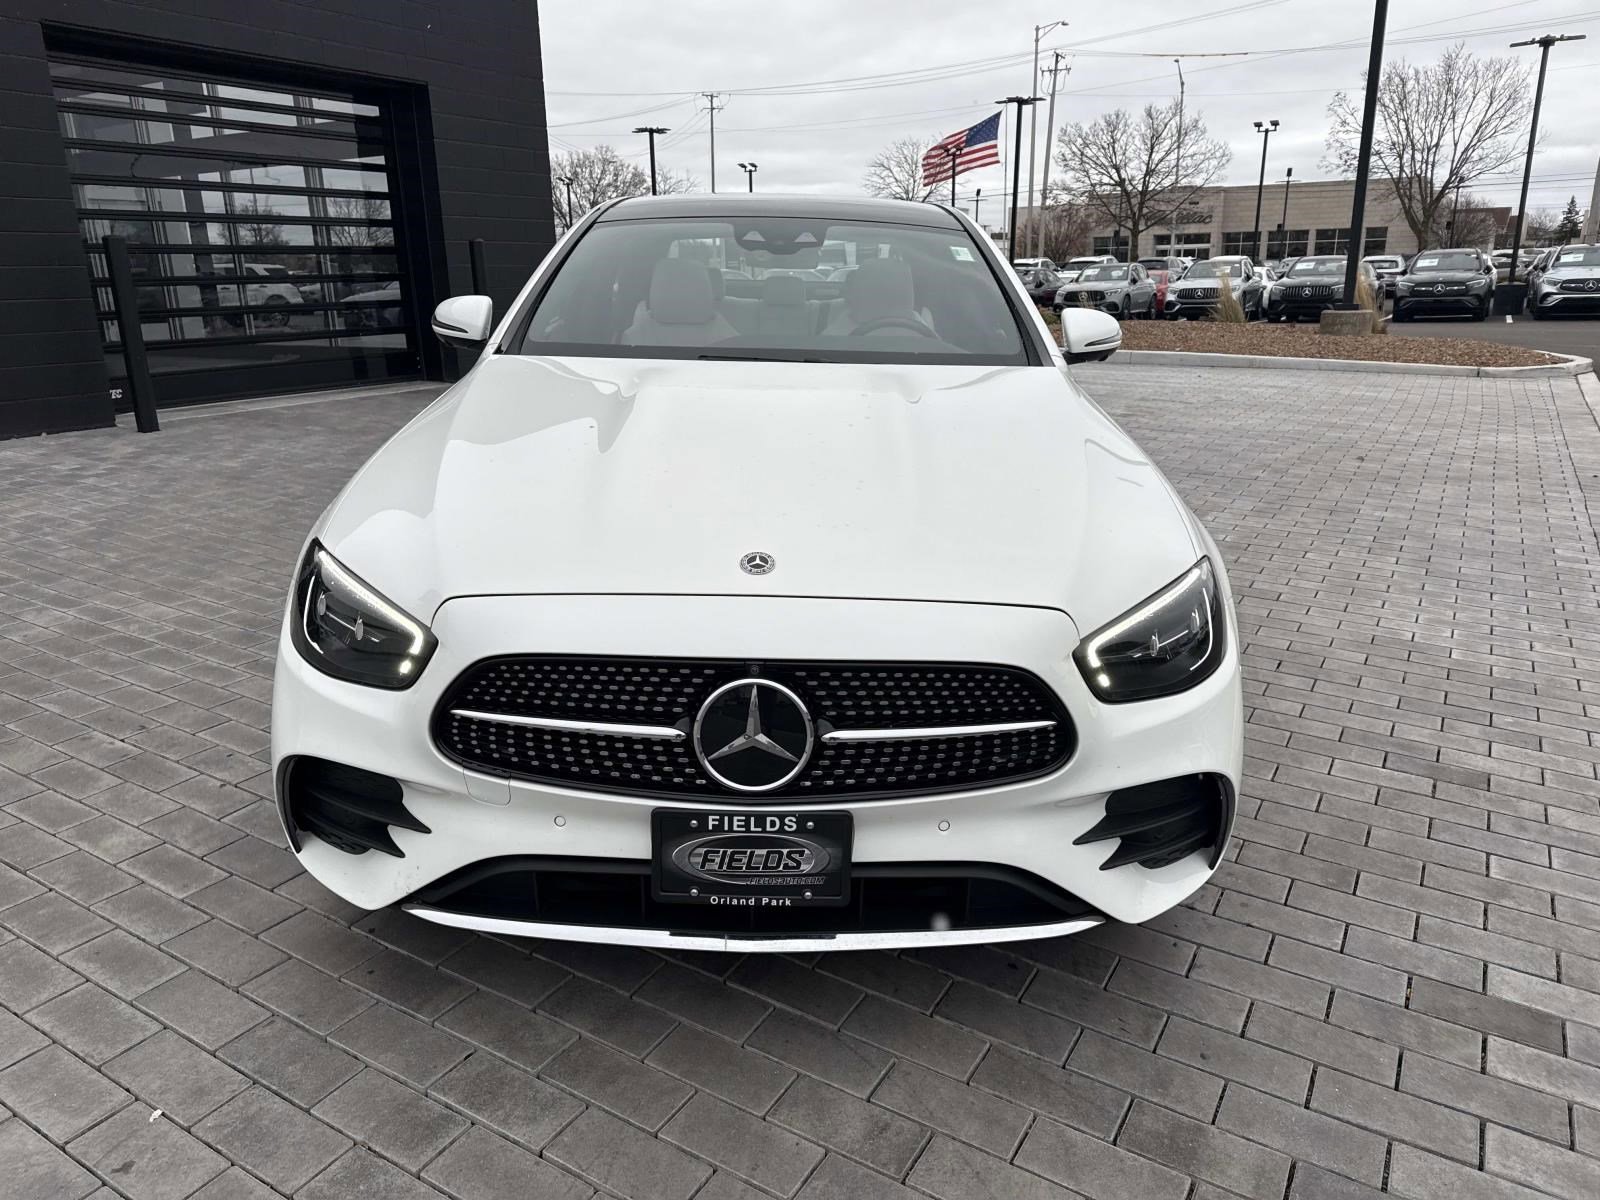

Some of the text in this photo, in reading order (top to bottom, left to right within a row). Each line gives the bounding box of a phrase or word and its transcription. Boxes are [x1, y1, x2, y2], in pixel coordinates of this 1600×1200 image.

[708, 815, 798, 832] FIELDS
[699, 849, 806, 871] FIELDS
[710, 896, 791, 906] Orland Park
